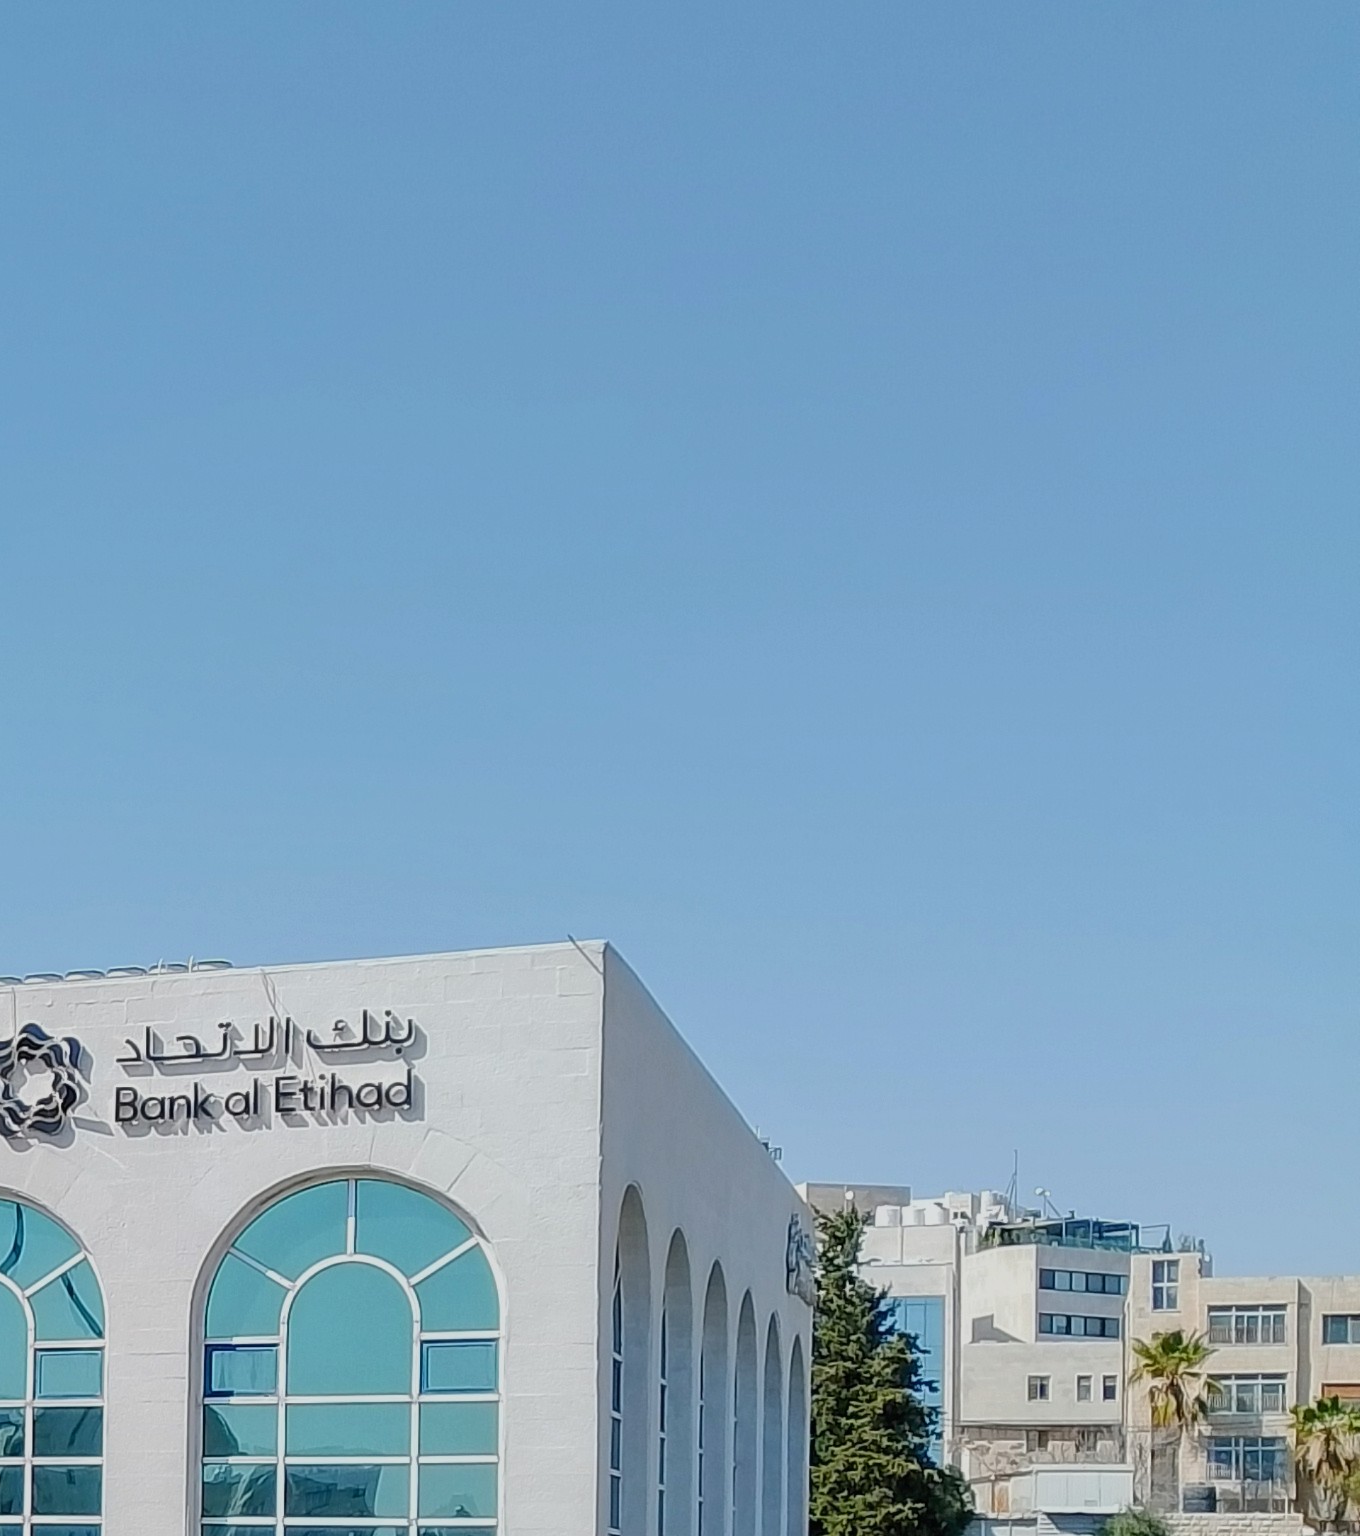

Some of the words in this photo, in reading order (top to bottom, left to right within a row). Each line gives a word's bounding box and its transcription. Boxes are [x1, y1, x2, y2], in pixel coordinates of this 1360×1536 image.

[115, 1015, 292, 1064] الاتحاد
[305, 1009, 414, 1056] بنك
[114, 1082, 214, 1122] Bank
[224, 1077, 260, 1118] al
[273, 1066, 413, 1113] Etihad
